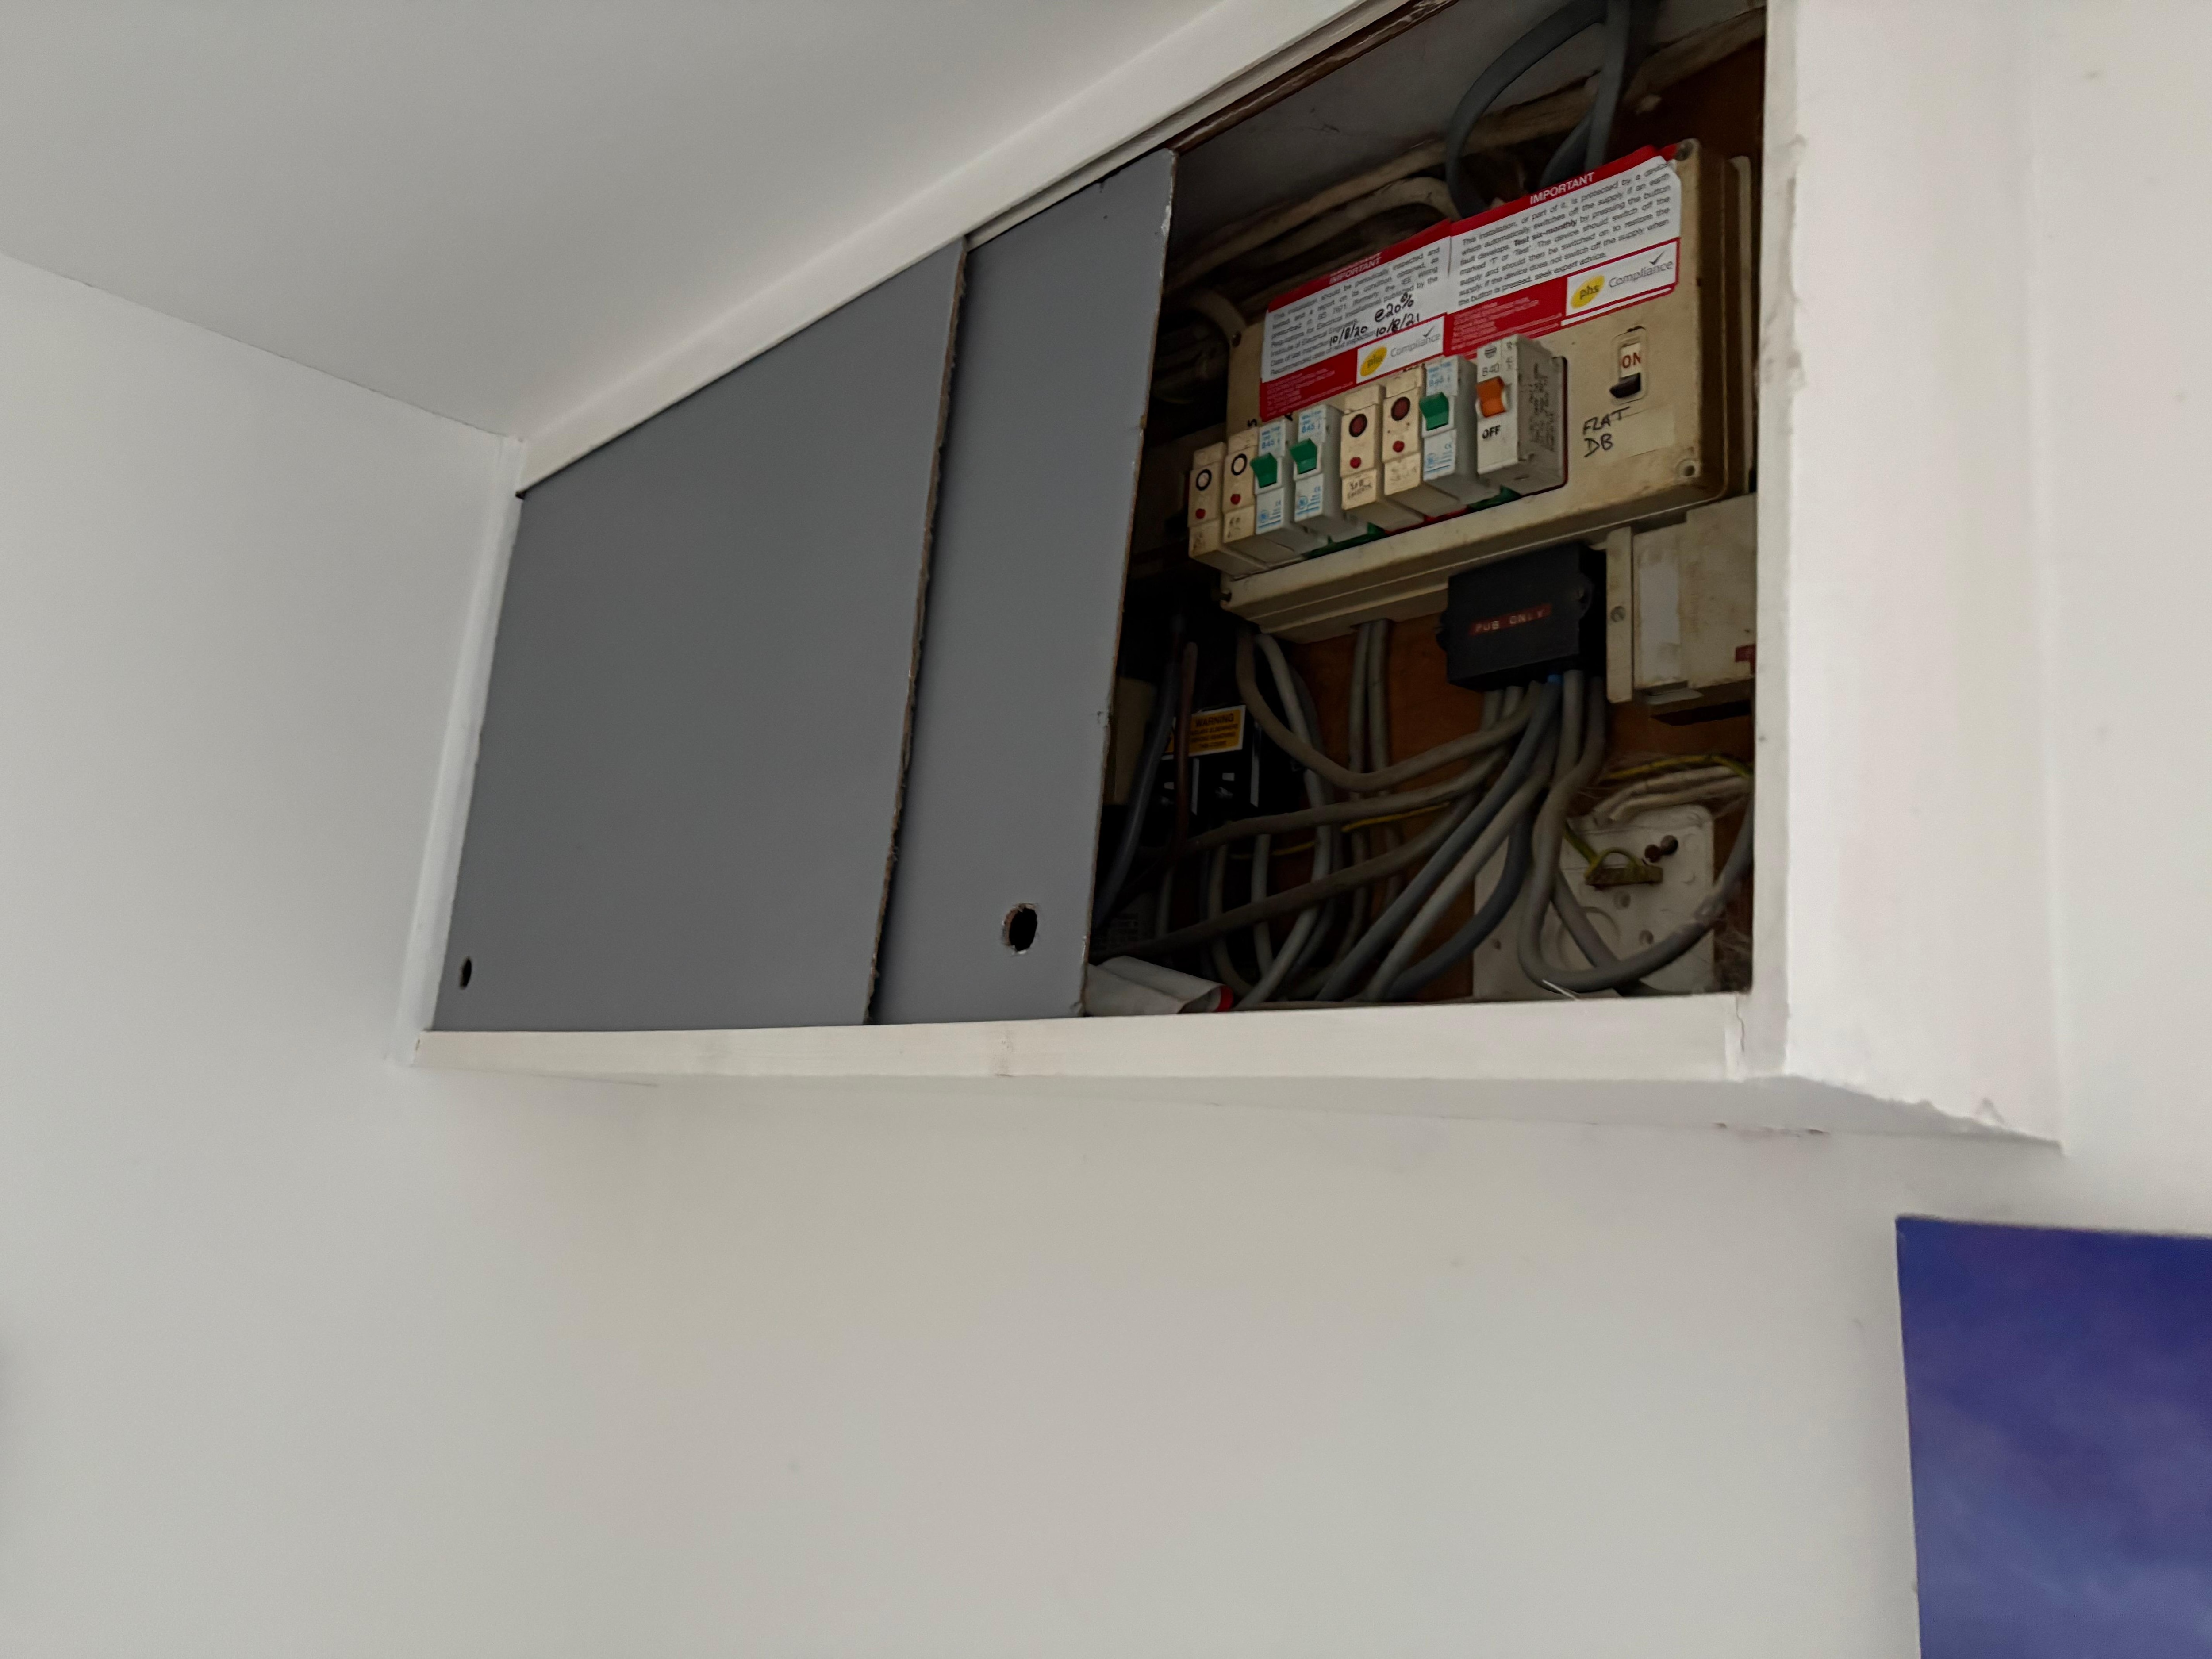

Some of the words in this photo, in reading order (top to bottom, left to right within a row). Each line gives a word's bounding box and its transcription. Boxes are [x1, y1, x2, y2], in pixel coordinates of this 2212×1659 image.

[1530, 171, 1594, 205] IMPORTANT
[1462, 235, 1476, 246] This
[1532, 210, 1546, 221] part
[1581, 182, 1618, 201] protected
[1622, 177, 1630, 186] by
[1514, 236, 1528, 246] Test
[1532, 219, 1576, 241] six-monthly
[1580, 214, 1589, 223] by
[1592, 201, 1625, 219] pressing
[1628, 195, 1640, 205] the
[1643, 184, 1670, 200] button
[1569, 207, 1578, 216] off
[1582, 202, 1594, 211] the
[1460, 261, 1486, 276] marked
[1537, 237, 1551, 248] The
[1554, 228, 1578, 242] device
[1583, 217, 1608, 232] should
[1612, 207, 1637, 221] switch
[1642, 201, 1652, 211] off
[1657, 195, 1669, 205] the
[1460, 273, 1482, 286] supply
[1485, 267, 1498, 276] and
[1502, 258, 1525, 271] should
[1528, 251, 1545, 261] then
[1548, 246, 1558, 254] be
[1561, 233, 1595, 250] switched
[1656, 206, 1669, 217] the
[1491, 276, 1502, 284] the
[1504, 267, 1527, 280] device
[1529, 260, 1548, 271] does
[1551, 255, 1561, 264] not
[1564, 246, 1588, 259] switch
[1591, 241, 1601, 250] off
[1603, 236, 1616, 246] the
[1647, 218, 1668, 230] when
[1329, 256, 1382, 284] IMPORTANT
[1417, 280, 1424, 289] by
[1427, 274, 1437, 284] the
[1609, 258, 1672, 289] Compliance
[1458, 297, 1469, 306] the
[1471, 289, 1492, 301] button
[1535, 269, 1552, 280] seek
[1554, 261, 1577, 274] expert
[1580, 282, 1599, 300] phs
[1318, 311, 1326, 320] BS
[1329, 323, 1368, 347] 10/8/20
[1391, 333, 1440, 357] Compliance
[1482, 363, 1500, 376] B40
[1621, 352, 1640, 368] ON
[1482, 425, 1501, 439] OFF
[1583, 406, 1630, 435] FLAT
[1584, 433, 1613, 457] DB
[1475, 621, 1499, 633] PUB
[1195, 713, 1234, 727] WARNING
